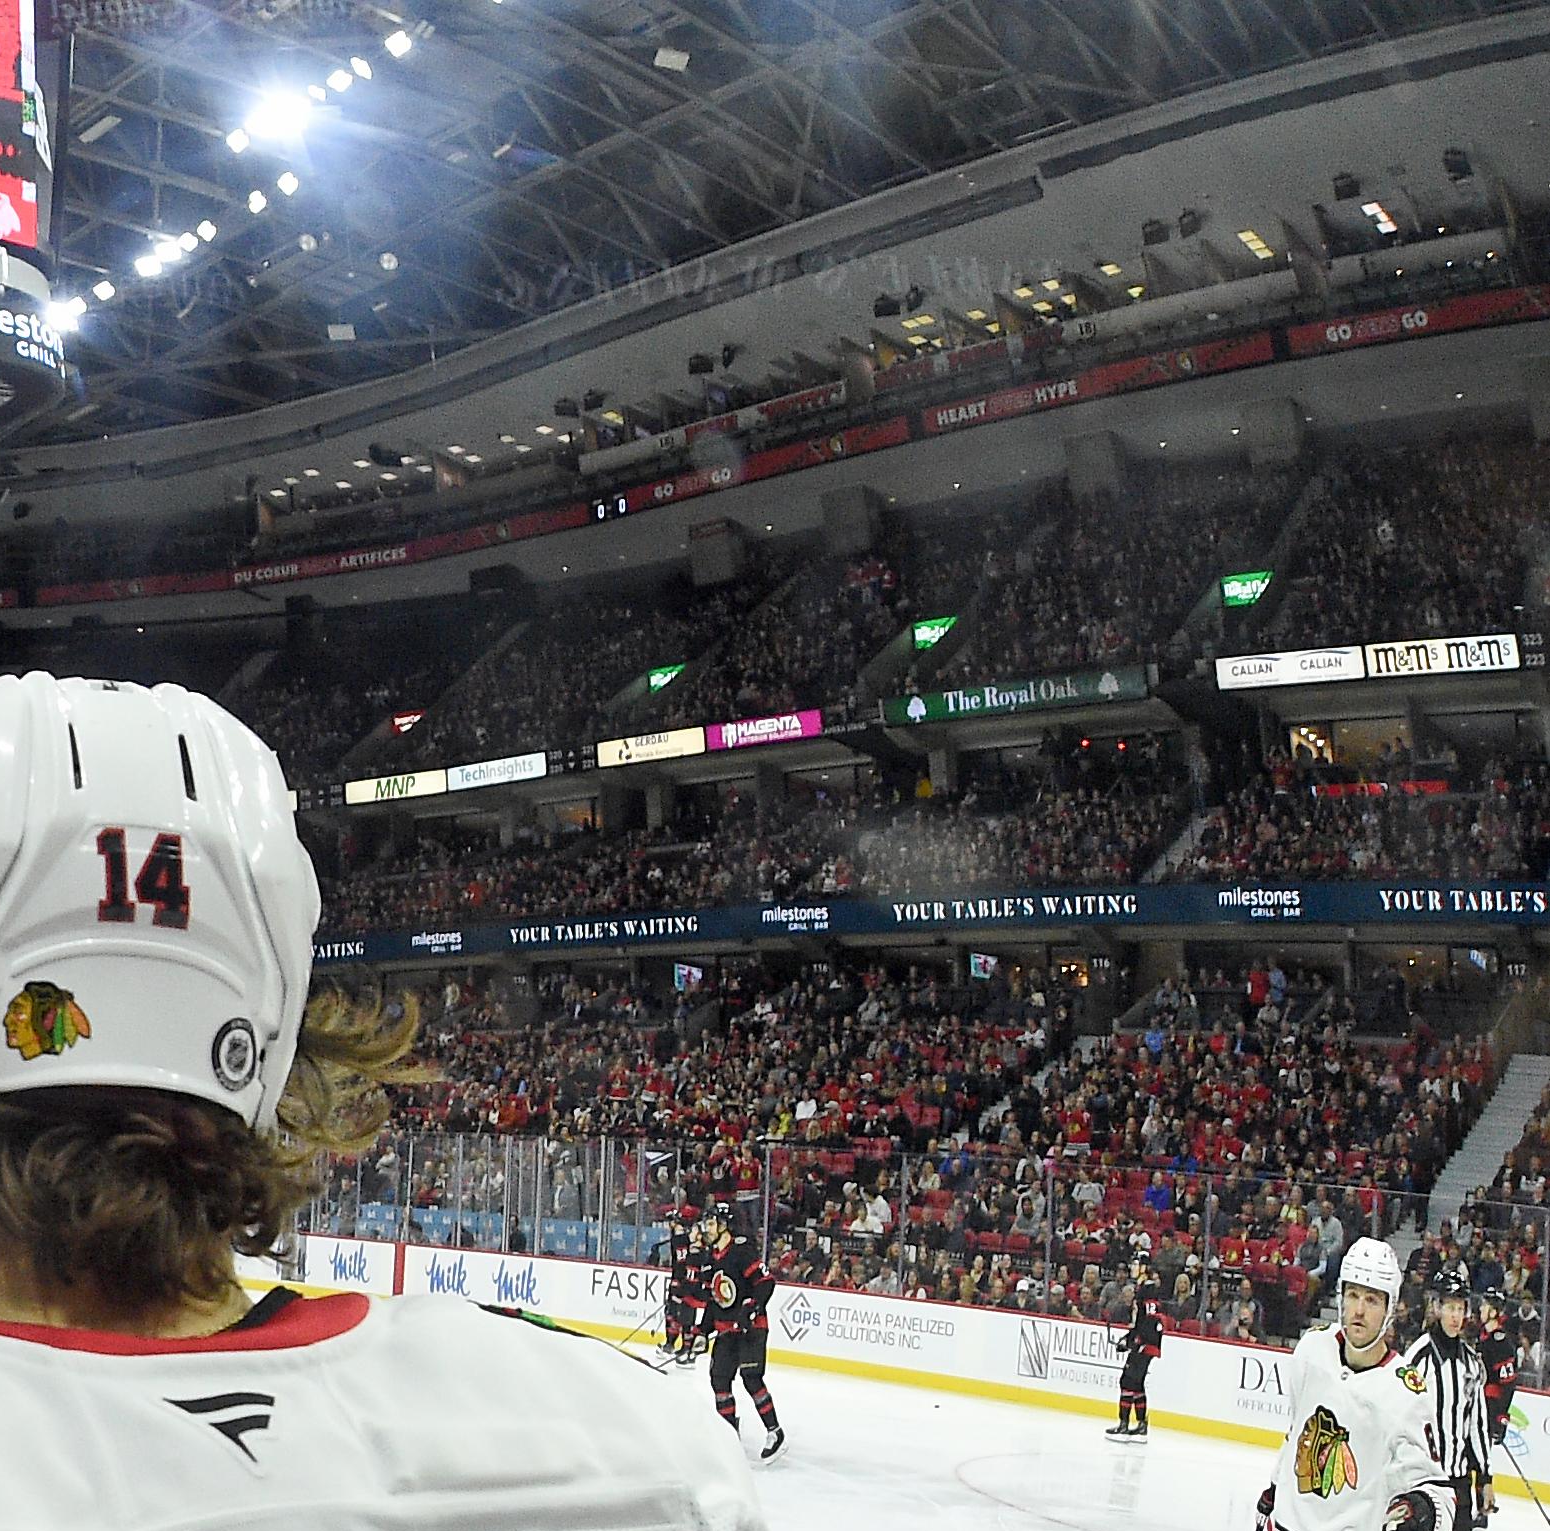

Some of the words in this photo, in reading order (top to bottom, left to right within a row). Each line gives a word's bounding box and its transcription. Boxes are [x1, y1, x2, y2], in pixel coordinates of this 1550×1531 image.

[339, 547, 407, 569] ARTIFICES
[1231, 661, 1274, 678] CALIAN
[1299, 656, 1344, 671] CALIAN
[943, 690, 981, 711] The
[982, 682, 1034, 712] Royal
[1037, 676, 1080, 700] Oak
[737, 714, 803, 738] MAGENTA
[634, 733, 670, 747] GERDAU
[458, 757, 534, 783] TechInsights
[374, 775, 417, 799] MNP
[95, 826, 192, 930] 14
[892, 900, 947, 922] YOUR
[951, 896, 1035, 920] TABLE'S
[1041, 894, 1138, 917] WAITING
[1218, 888, 1301, 908] milestones
[1378, 889, 1443, 912] YOUR
[1449, 888, 1547, 914] TABLE'S
[761, 905, 829, 924] milestones
[411, 931, 462, 949] milestones
[508, 925, 551, 945] YOUR
[554, 919, 619, 941] TABLE'S
[623, 915, 699, 938] WAITING
[791, 1307, 821, 1327] OPS
[826, 1304, 881, 1329] OTTAWA
[884, 1312, 955, 1337] PANELIZED
[825, 1323, 895, 1349] SOLUTIONS
[898, 1332, 924, 1351] INC.
[1052, 1324, 1128, 1362] MILLENN
[1051, 1367, 1106, 1388] LIMOUSINE
[1499, 1363, 1515, 1381] 43
[1236, 1398, 1287, 1417] OFFICIAL
